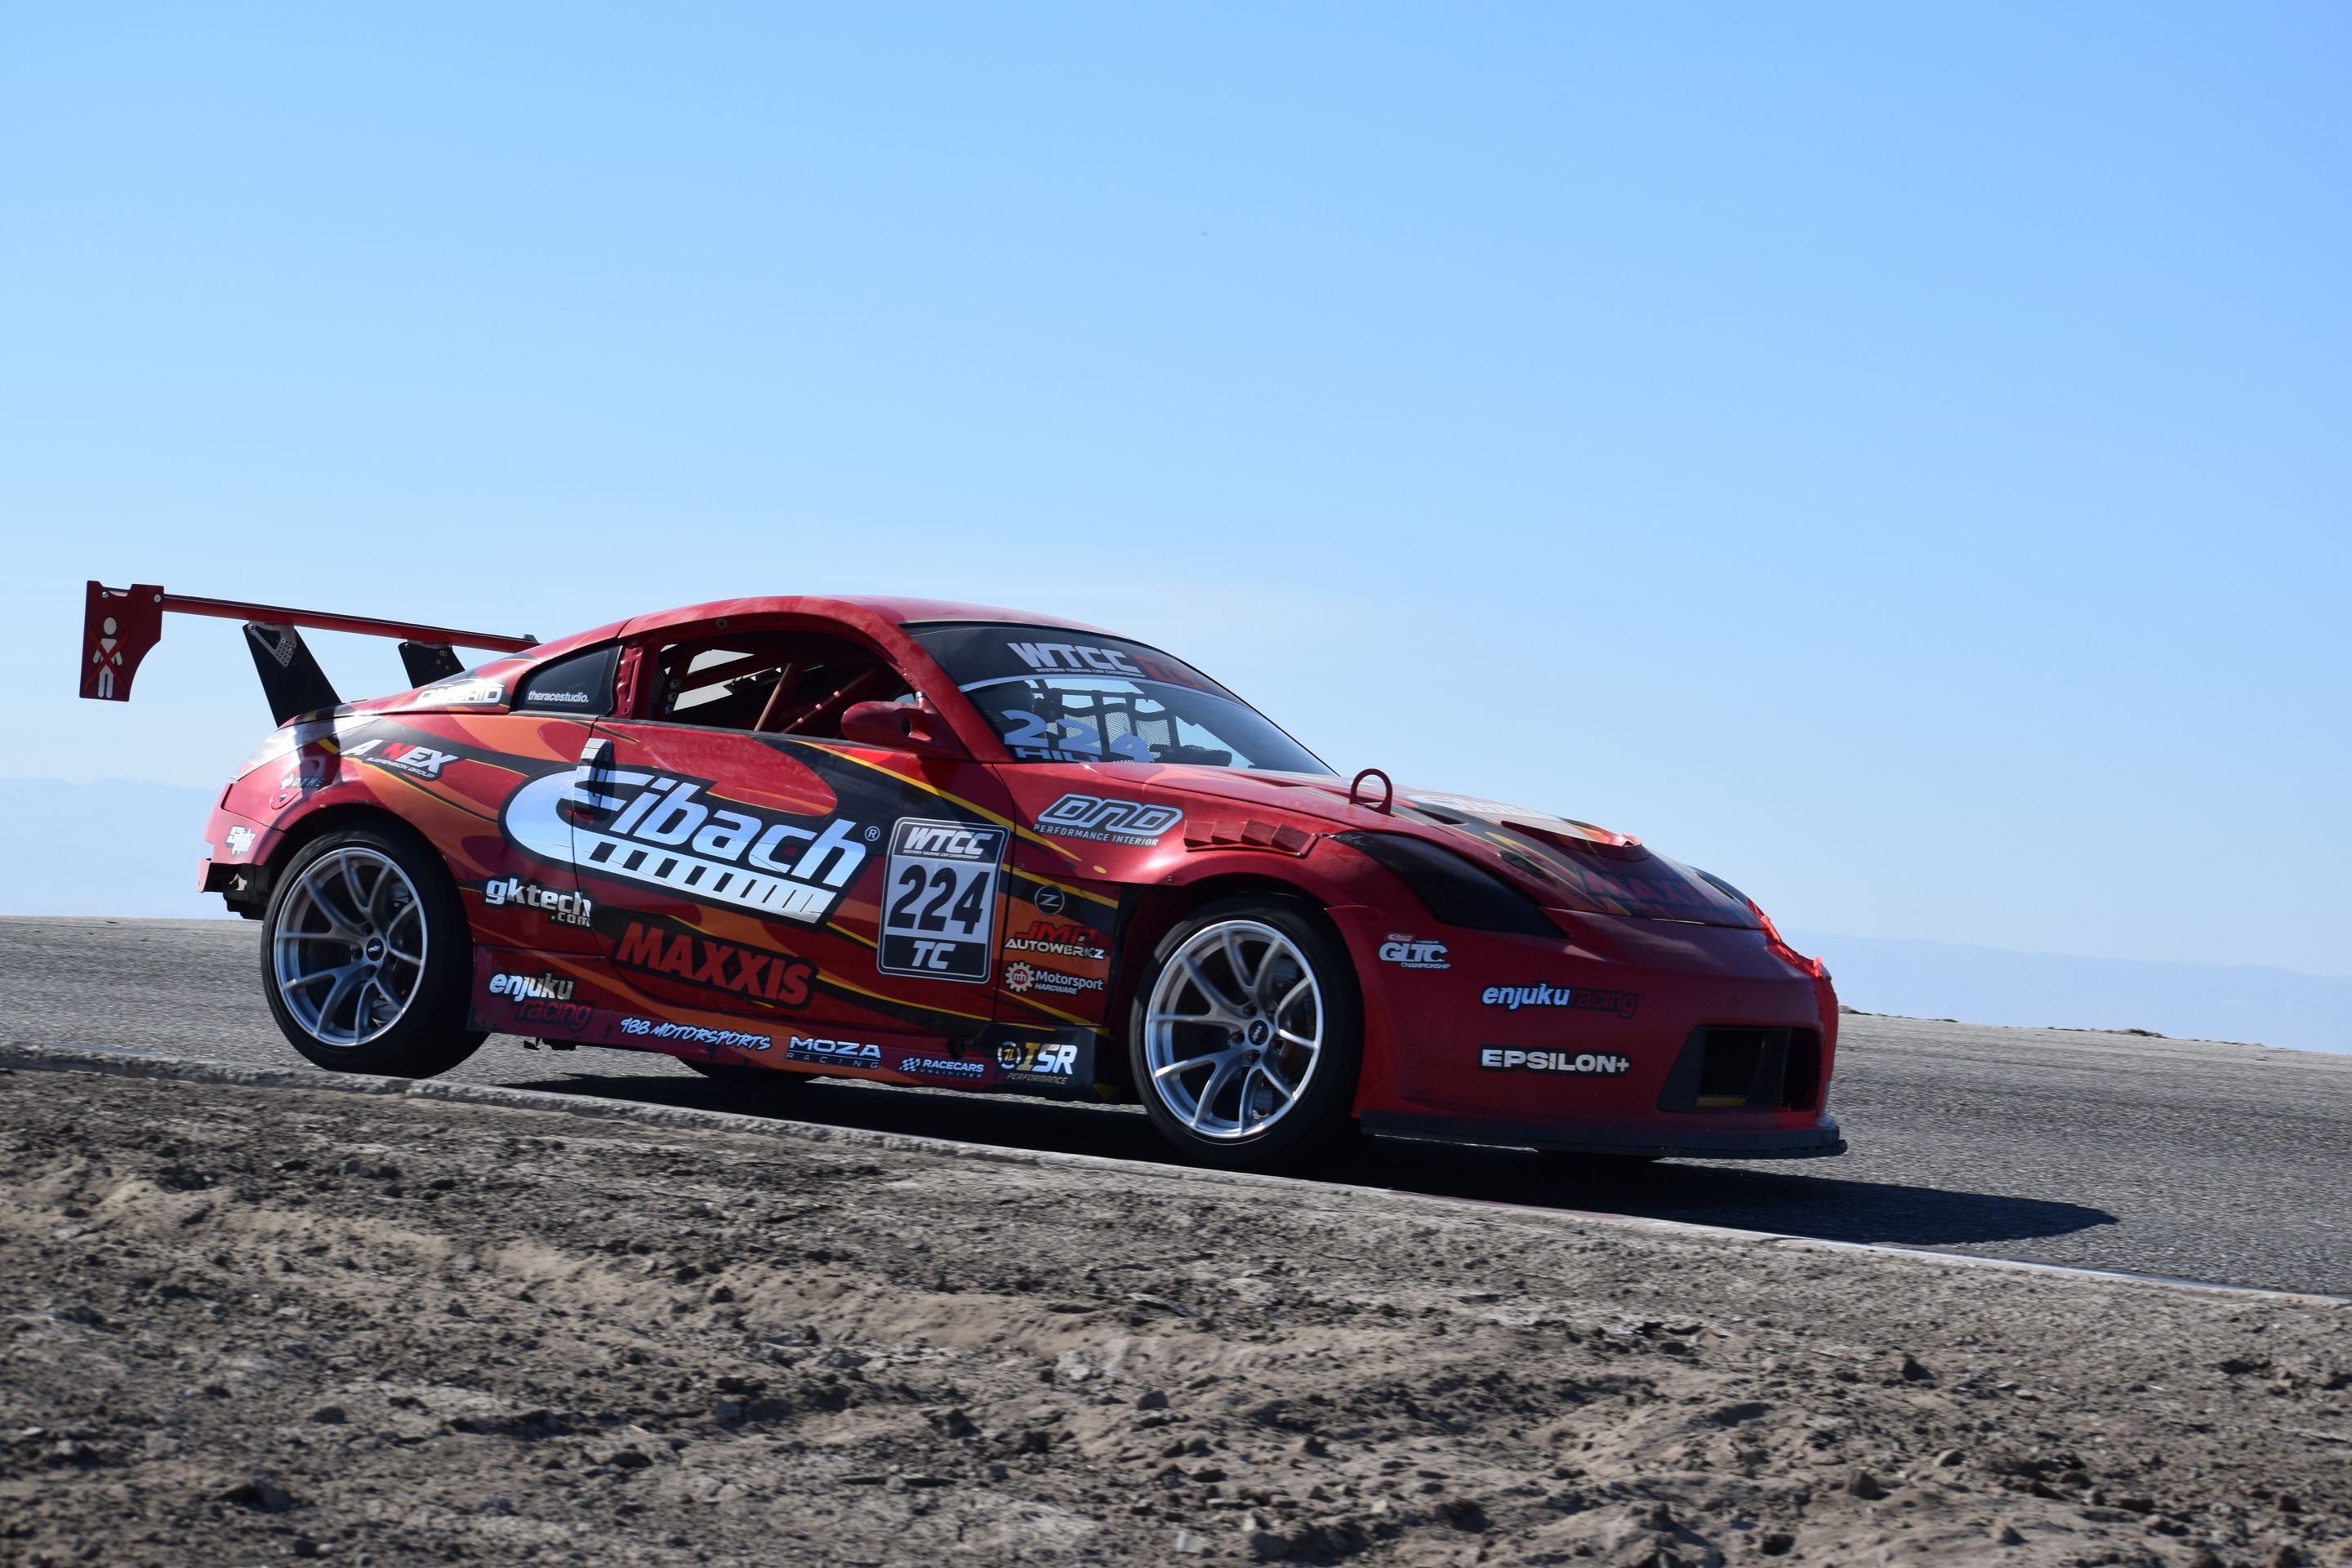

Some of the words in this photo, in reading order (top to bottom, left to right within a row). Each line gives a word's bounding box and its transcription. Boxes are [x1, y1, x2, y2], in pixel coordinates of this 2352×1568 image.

[1006, 643, 1143, 673] WTCC
[528, 691, 590, 703] theracestudio.
[1000, 710, 1156, 763] 224
[340, 738, 459, 773] ANEX
[408, 766, 435, 778] GROUP
[506, 764, 866, 889] Eibach
[1033, 823, 1111, 842] PERFORMANCE
[1111, 835, 1159, 846] INTERIOR
[903, 826, 994, 855] WTCC
[485, 877, 592, 917] gktech
[887, 864, 991, 935] 224
[551, 912, 590, 927] .com
[1014, 921, 1098, 945] JMP
[911, 940, 956, 969] TC
[1004, 938, 1105, 960] AUTOWERKZ
[1379, 942, 1449, 962] GLTC
[615, 922, 816, 1005] MAXXIS
[489, 973, 575, 1002] enjuku
[1035, 982, 1078, 995] HARDWARE
[1036, 970, 1103, 991] Motorsport
[519, 999, 592, 1030] racing
[621, 1017, 651, 1034] 988
[651, 1022, 772, 1050] MOTORSPORTS
[789, 1036, 882, 1058] MOZA
[1016, 1041, 1078, 1075] ISR
[786, 1052, 880, 1069] RACING
[922, 1058, 985, 1073] RACECARS
[1481, 1049, 1629, 1073] EPSILON+
[920, 1068, 982, 1078] UNLIMITED
[1006, 1072, 1068, 1085] PERFORMANCE
